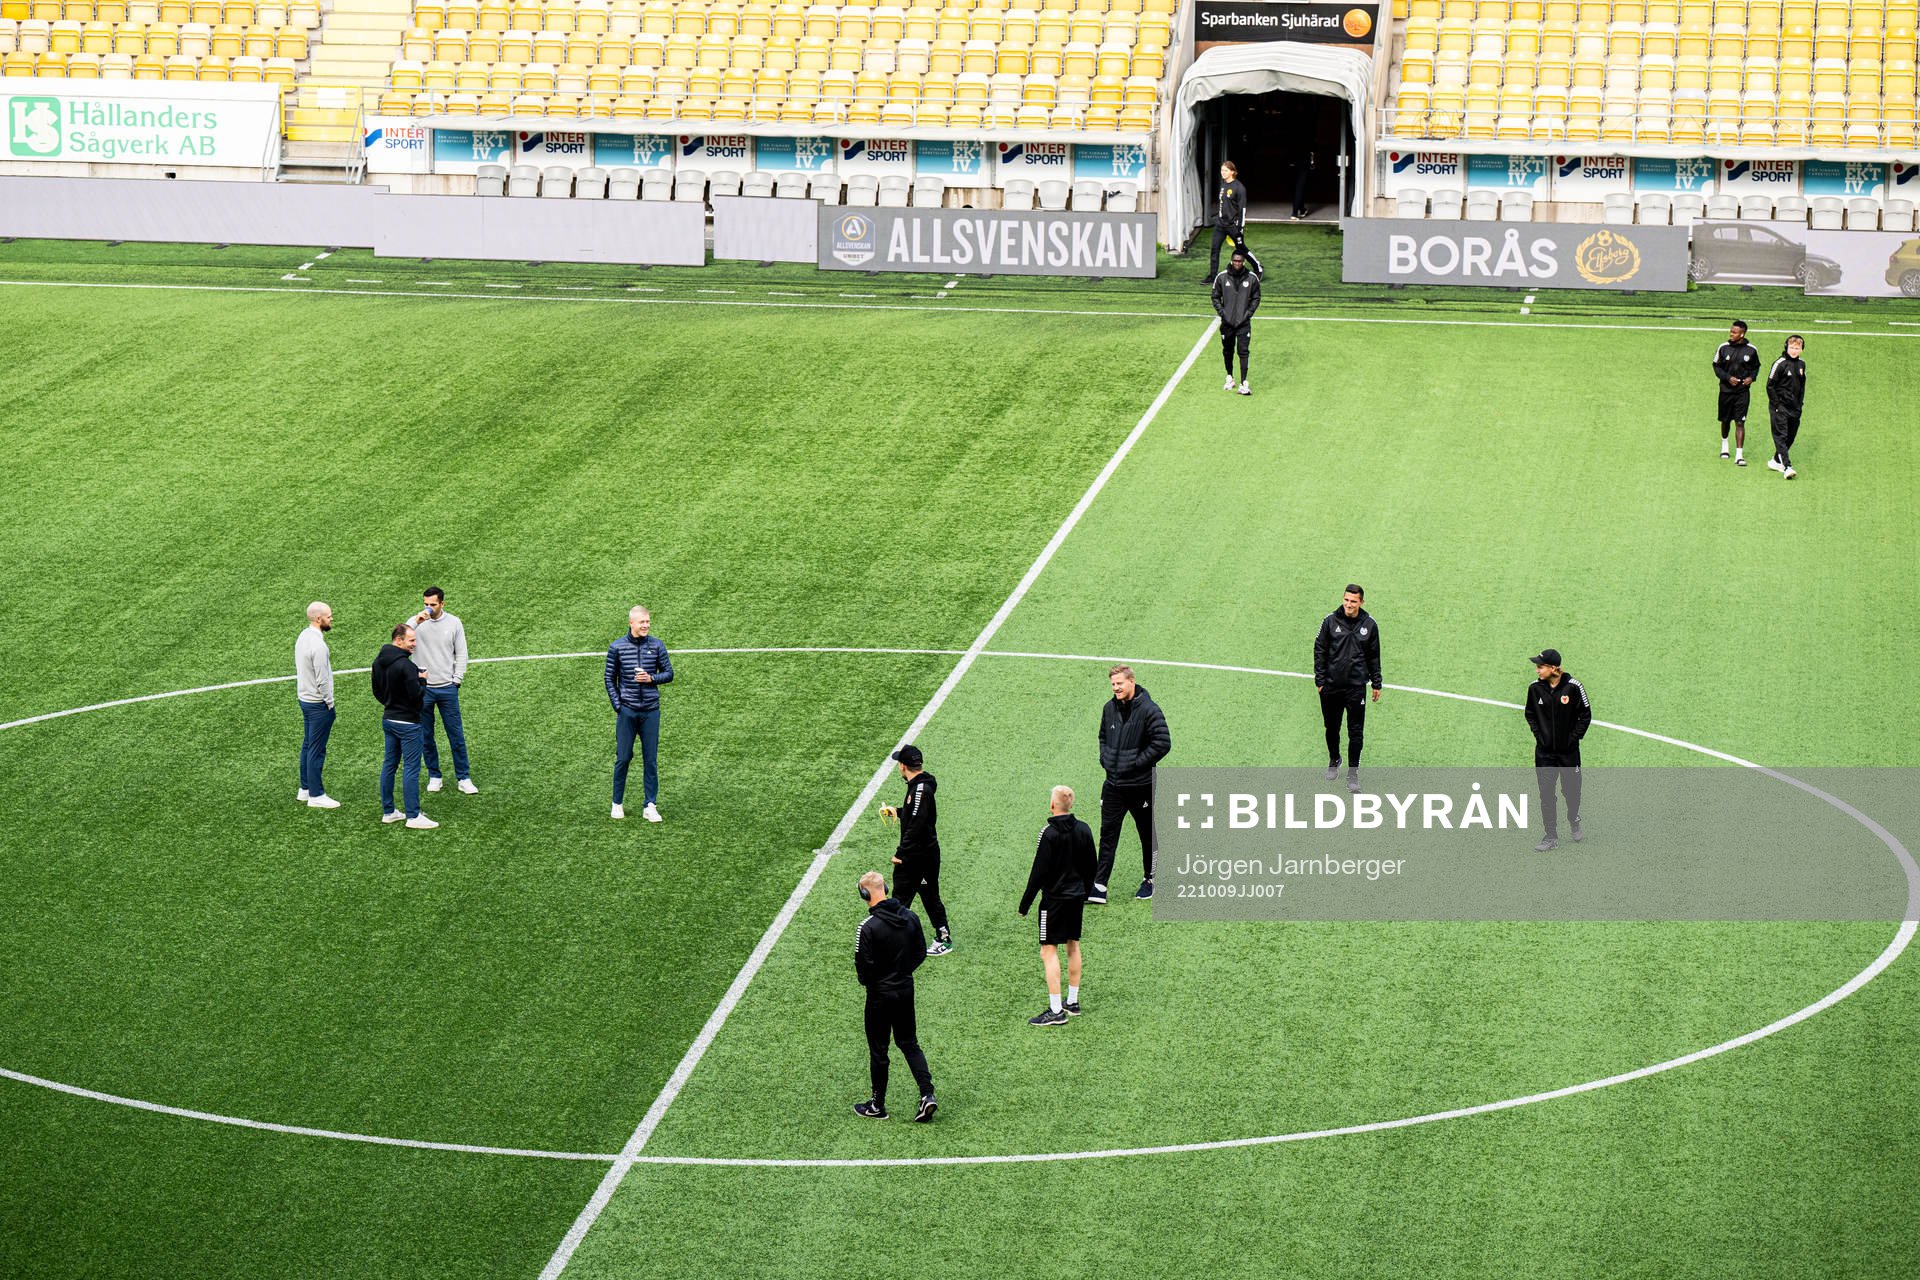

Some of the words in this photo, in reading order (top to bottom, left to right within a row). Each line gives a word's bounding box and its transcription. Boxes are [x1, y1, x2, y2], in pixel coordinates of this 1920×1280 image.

[1201, 12, 1278, 27] Sparbanken
[1281, 13, 1340, 29] Sjuhärad
[69, 101, 217, 129] Hållanders
[385, 127, 425, 138] INTER
[545, 132, 585, 143] INTER
[69, 131, 169, 159] Sågverk
[179, 135, 216, 156] AB
[385, 139, 425, 149] SPORT
[706, 136, 747, 147] INTER
[867, 139, 907, 150] INTER
[545, 143, 585, 154] SPORT
[706, 147, 747, 158] SPORT
[1025, 143, 1066, 154] INTER
[867, 151, 907, 162] SPORT
[1025, 154, 1066, 165] SPORT
[1417, 152, 1458, 164] INTER
[1583, 156, 1625, 168] INTER
[1416, 164, 1458, 175] SPORT
[1752, 160, 1794, 171] INTER
[1583, 168, 1625, 179] SPORT
[1751, 171, 1794, 183] SPORT
[887, 217, 1143, 269] ALLSVENSKAN
[1388, 228, 1558, 279] BORÅS
